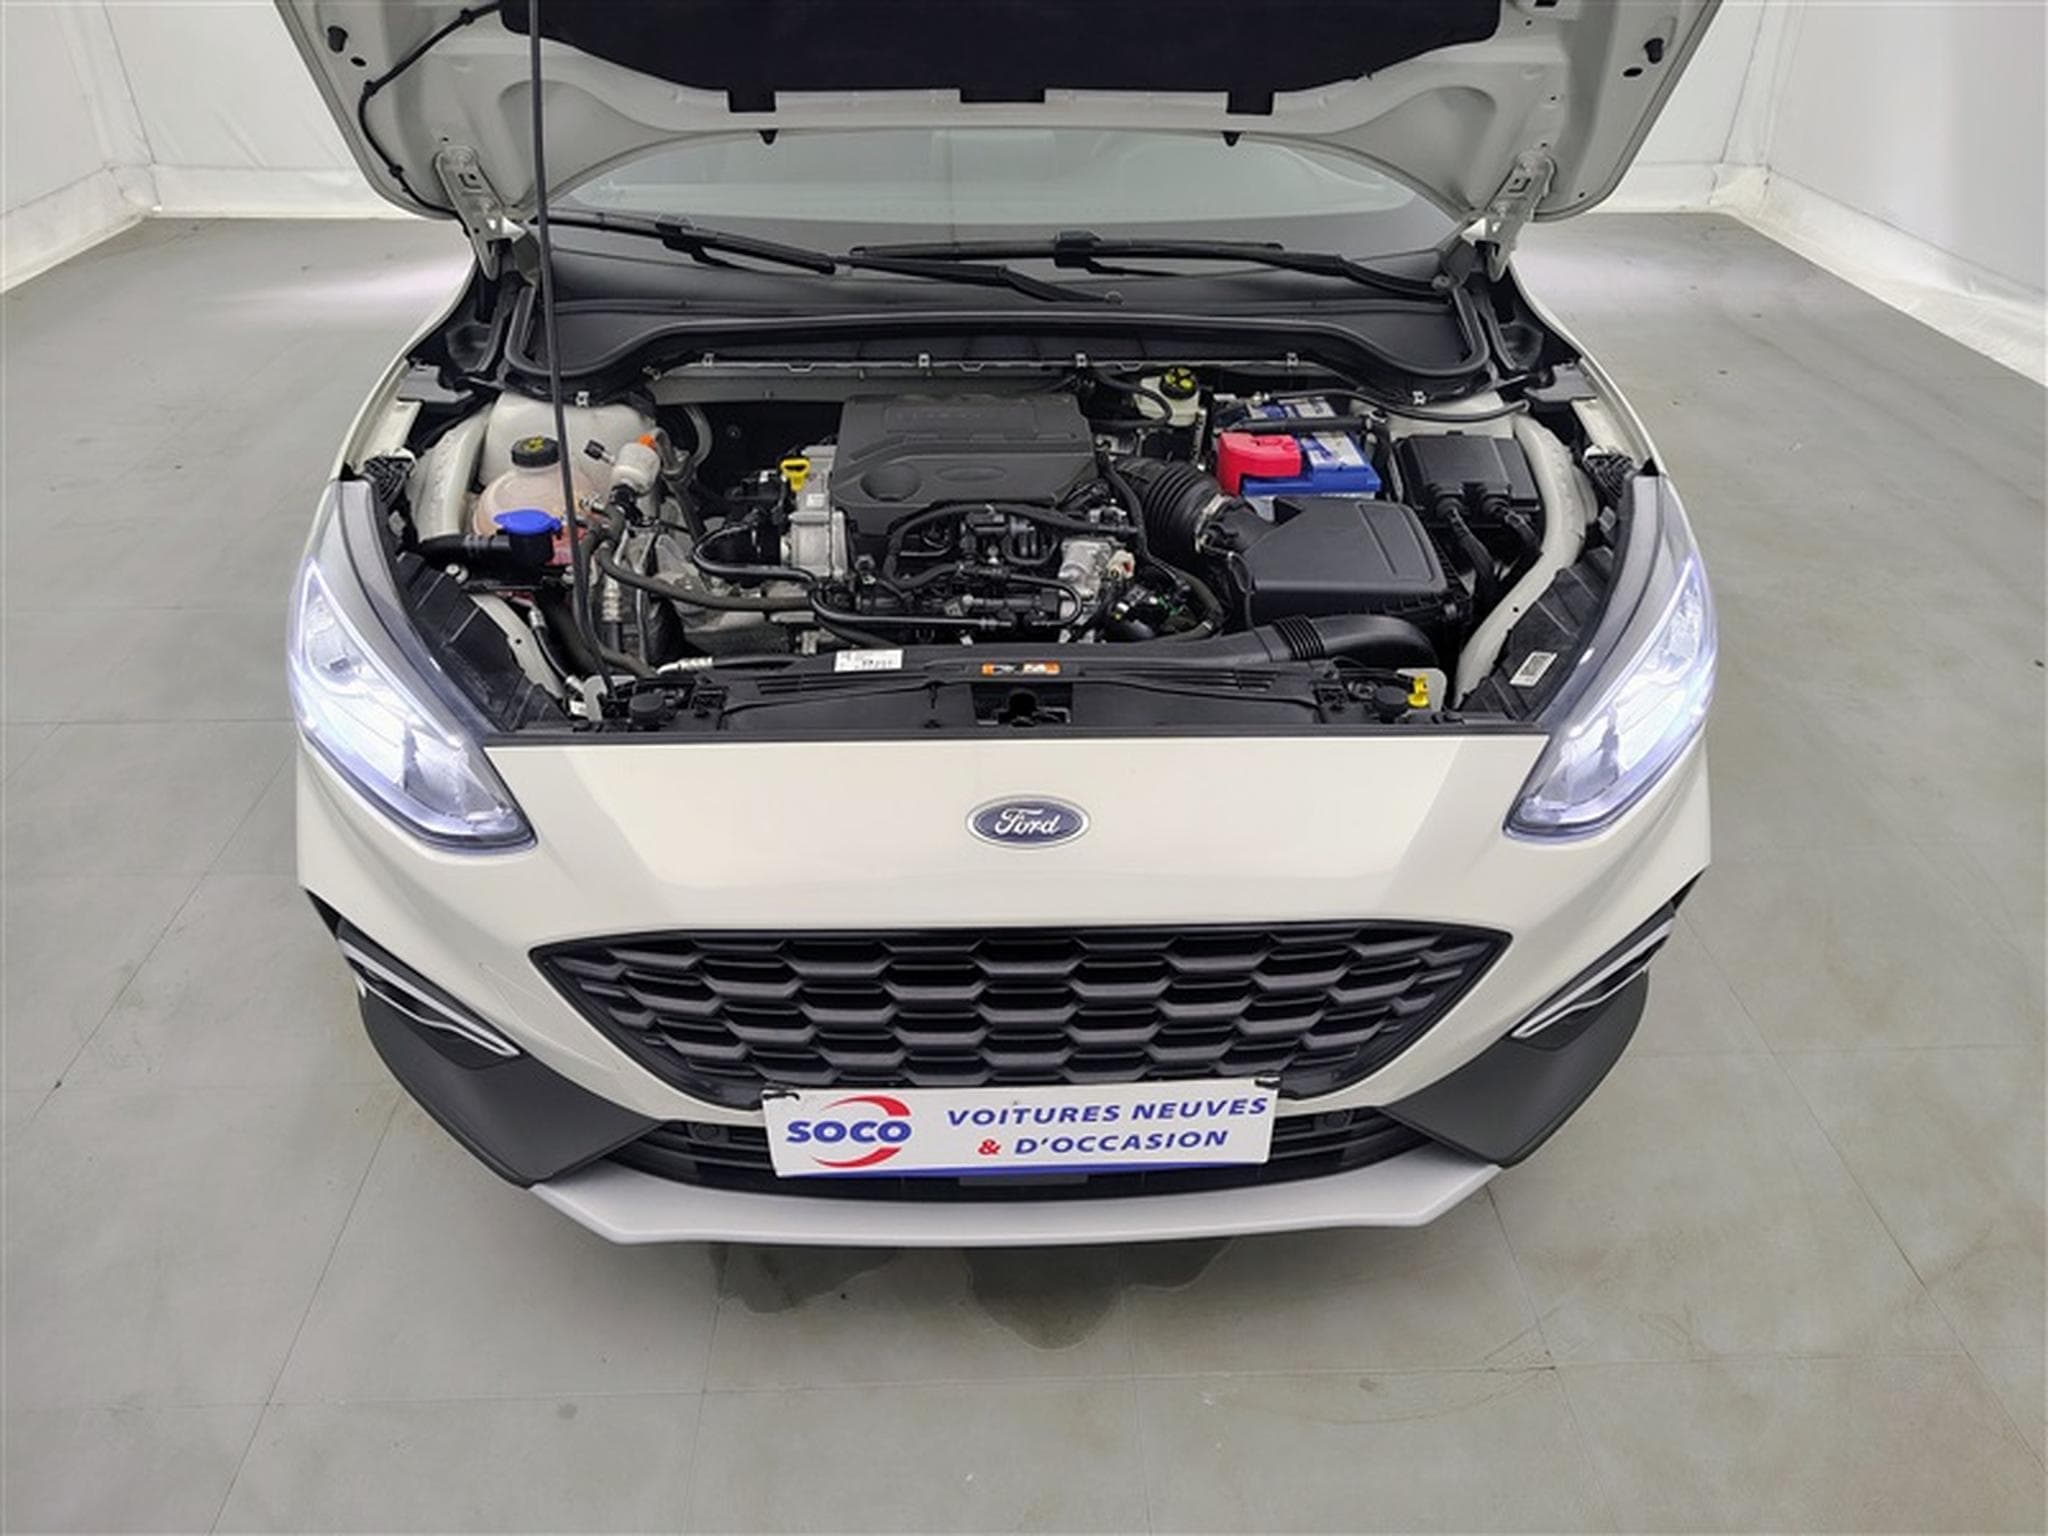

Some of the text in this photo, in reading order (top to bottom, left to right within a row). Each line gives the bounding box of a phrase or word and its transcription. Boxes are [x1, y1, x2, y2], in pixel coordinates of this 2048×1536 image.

[994, 807, 1061, 835] Ford
[947, 1097, 1267, 1126] VOITURES NEUVES
[787, 1120, 911, 1144] SOCO
[978, 1130, 1228, 1156] & D'OCCASION
